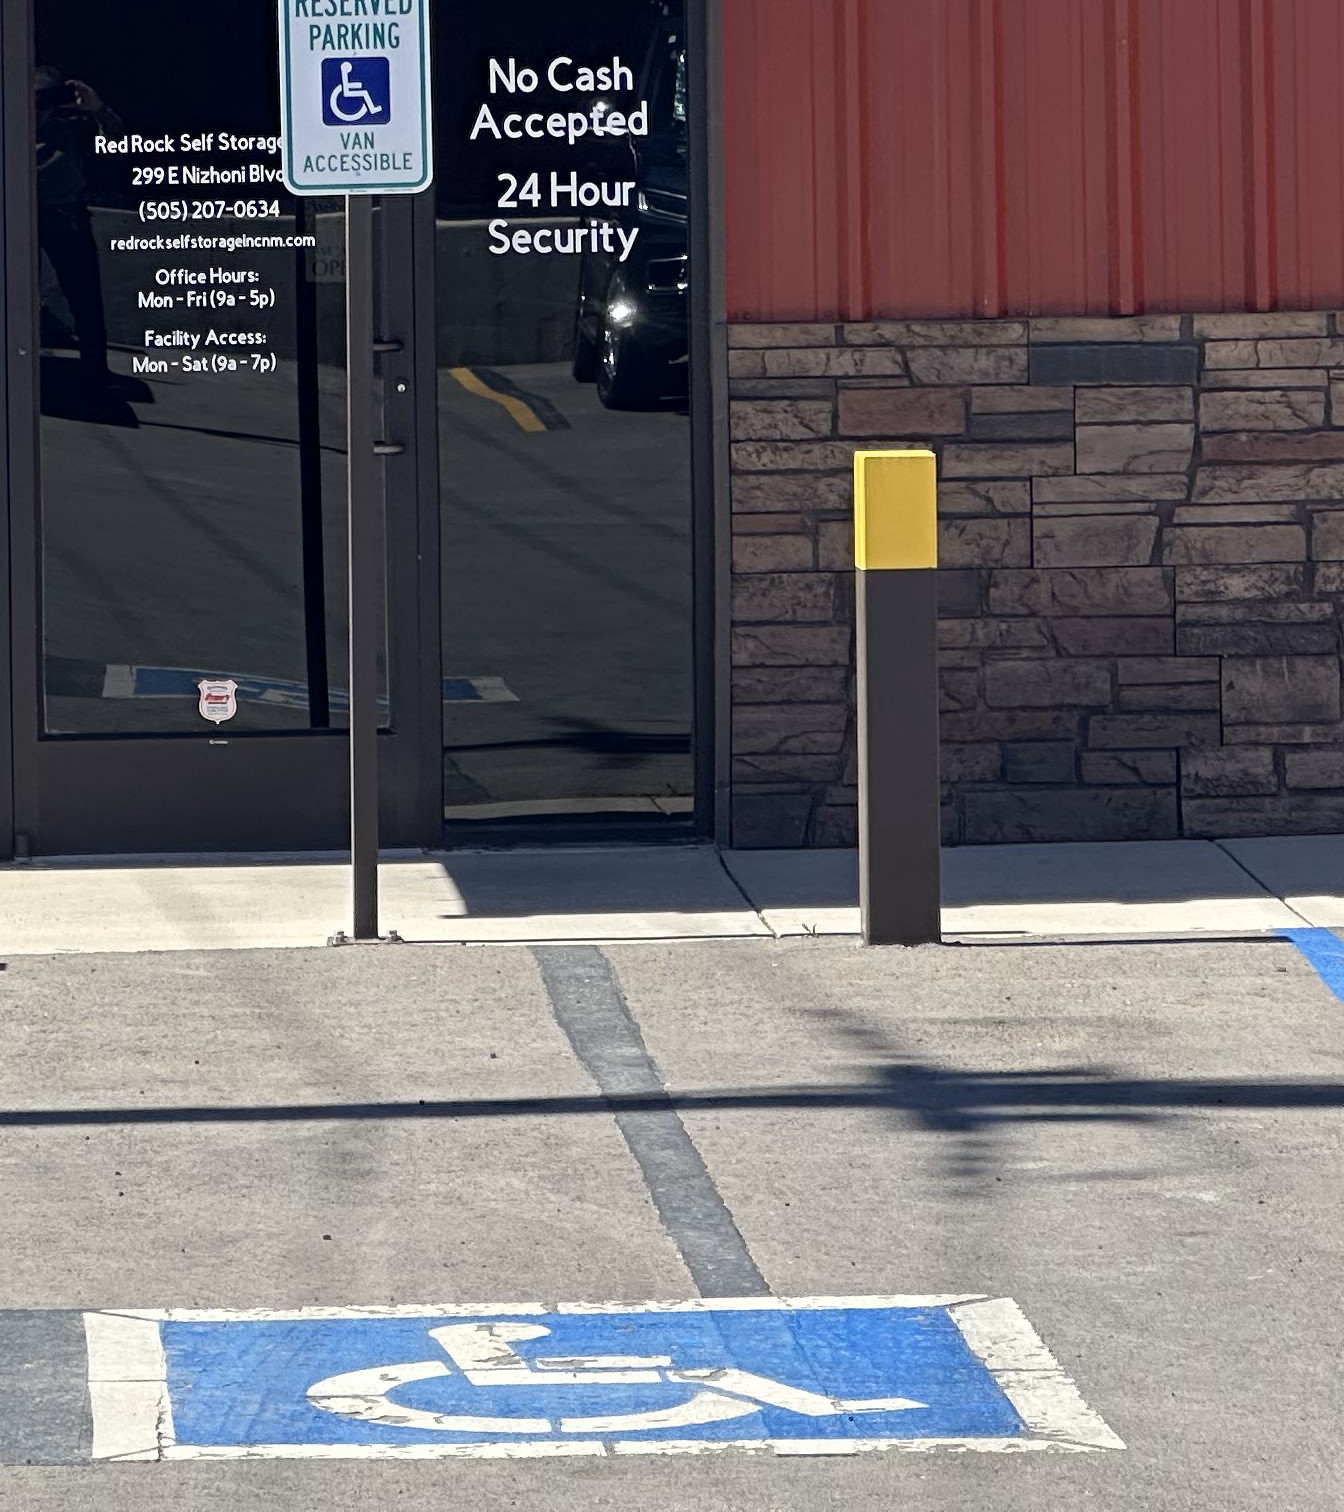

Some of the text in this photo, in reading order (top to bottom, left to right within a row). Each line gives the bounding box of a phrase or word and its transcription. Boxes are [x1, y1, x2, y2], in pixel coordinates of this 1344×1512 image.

[309, 22, 400, 51] PARKING
[489, 55, 634, 94] No Cash
[469, 100, 648, 145] Accepted
[94, 135, 129, 154] Red
[131, 134, 175, 153] Rock
[180, 133, 214, 152] Self
[340, 131, 375, 150] VAN
[304, 152, 413, 173] ACCESSIBLE
[131, 166, 165, 186] 299
[168, 166, 180, 185] E
[182, 165, 246, 185] Nizhoni
[497, 171, 636, 208] 24 Hour
[138, 199, 280, 223] (505) 207-0634
[488, 218, 640, 263] Security
[155, 266, 260, 286] Office Hours:
[138, 291, 174, 309] Mon
[186, 290, 207, 308] Fri
[209, 289, 236, 309] (9a
[249, 288, 276, 309] 5p)
[144, 328, 267, 350] Facility Access:
[132, 356, 168, 373] Mon
[182, 355, 209, 372] Sat
[211, 353, 237, 373] (9a
[250, 352, 277, 373] 7p)
